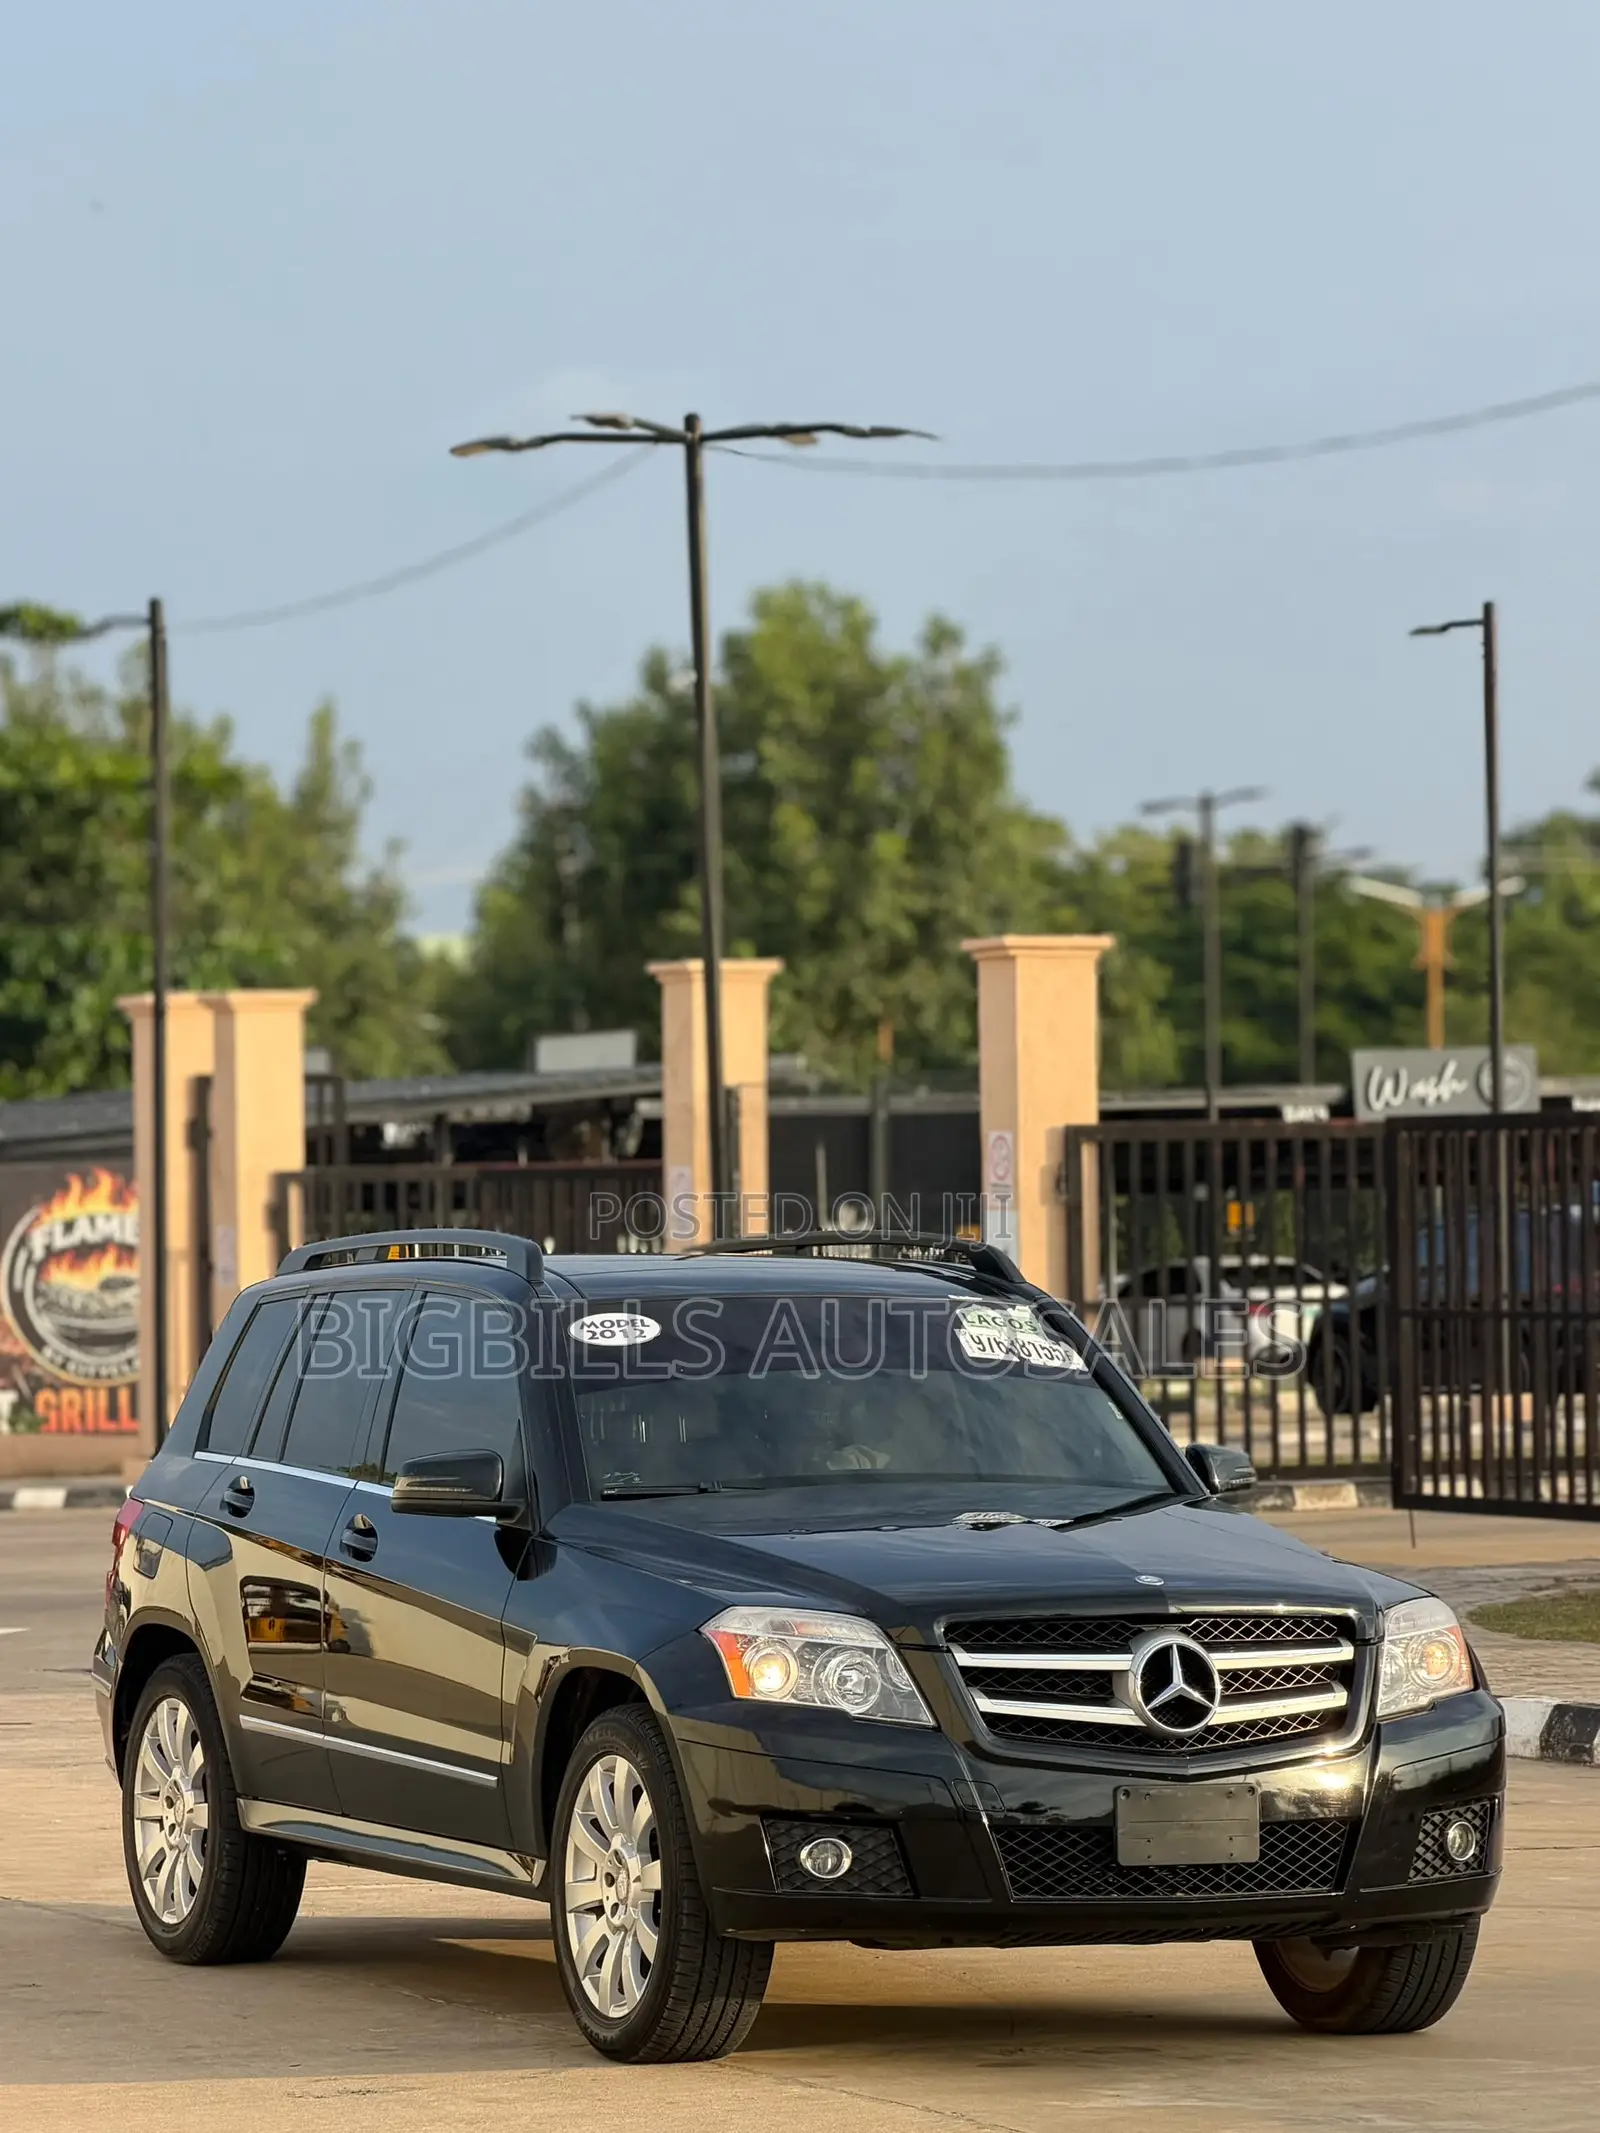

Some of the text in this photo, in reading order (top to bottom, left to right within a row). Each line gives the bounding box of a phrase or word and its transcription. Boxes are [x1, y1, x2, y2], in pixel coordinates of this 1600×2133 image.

[1369, 1059, 1468, 1112] Wash
[580, 1319, 650, 1330] MODEL
[962, 1312, 1037, 1332] LAGOS
[586, 1328, 647, 1340] 2012
[35, 1386, 139, 1434] GRILL
